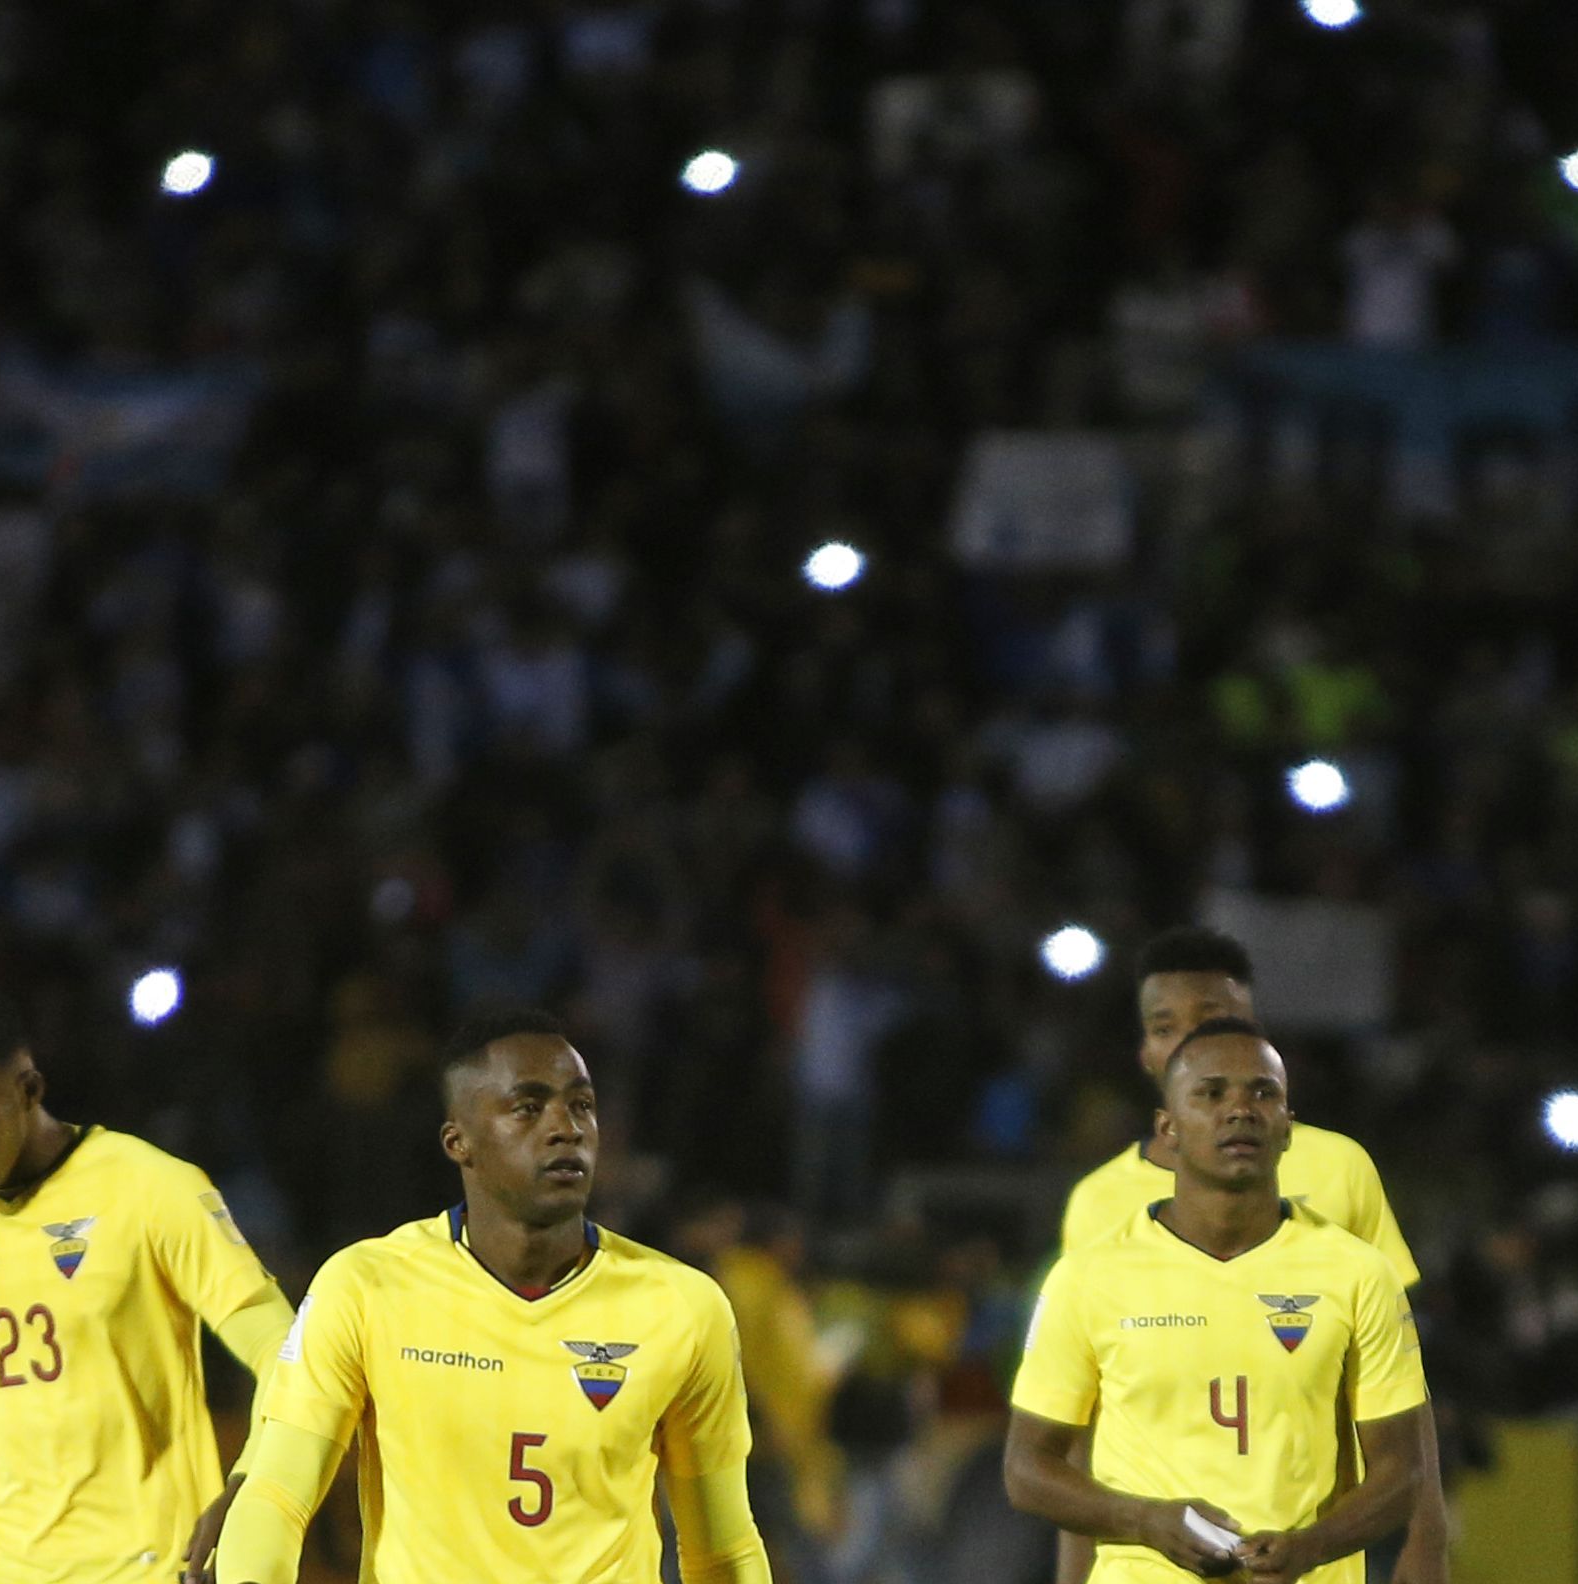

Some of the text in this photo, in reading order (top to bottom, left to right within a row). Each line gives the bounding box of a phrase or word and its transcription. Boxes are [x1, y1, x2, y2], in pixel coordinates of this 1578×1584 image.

[400, 1347, 504, 1372] marathon
[1209, 1375, 1249, 1455] 4
[507, 1432, 554, 1527] 5
